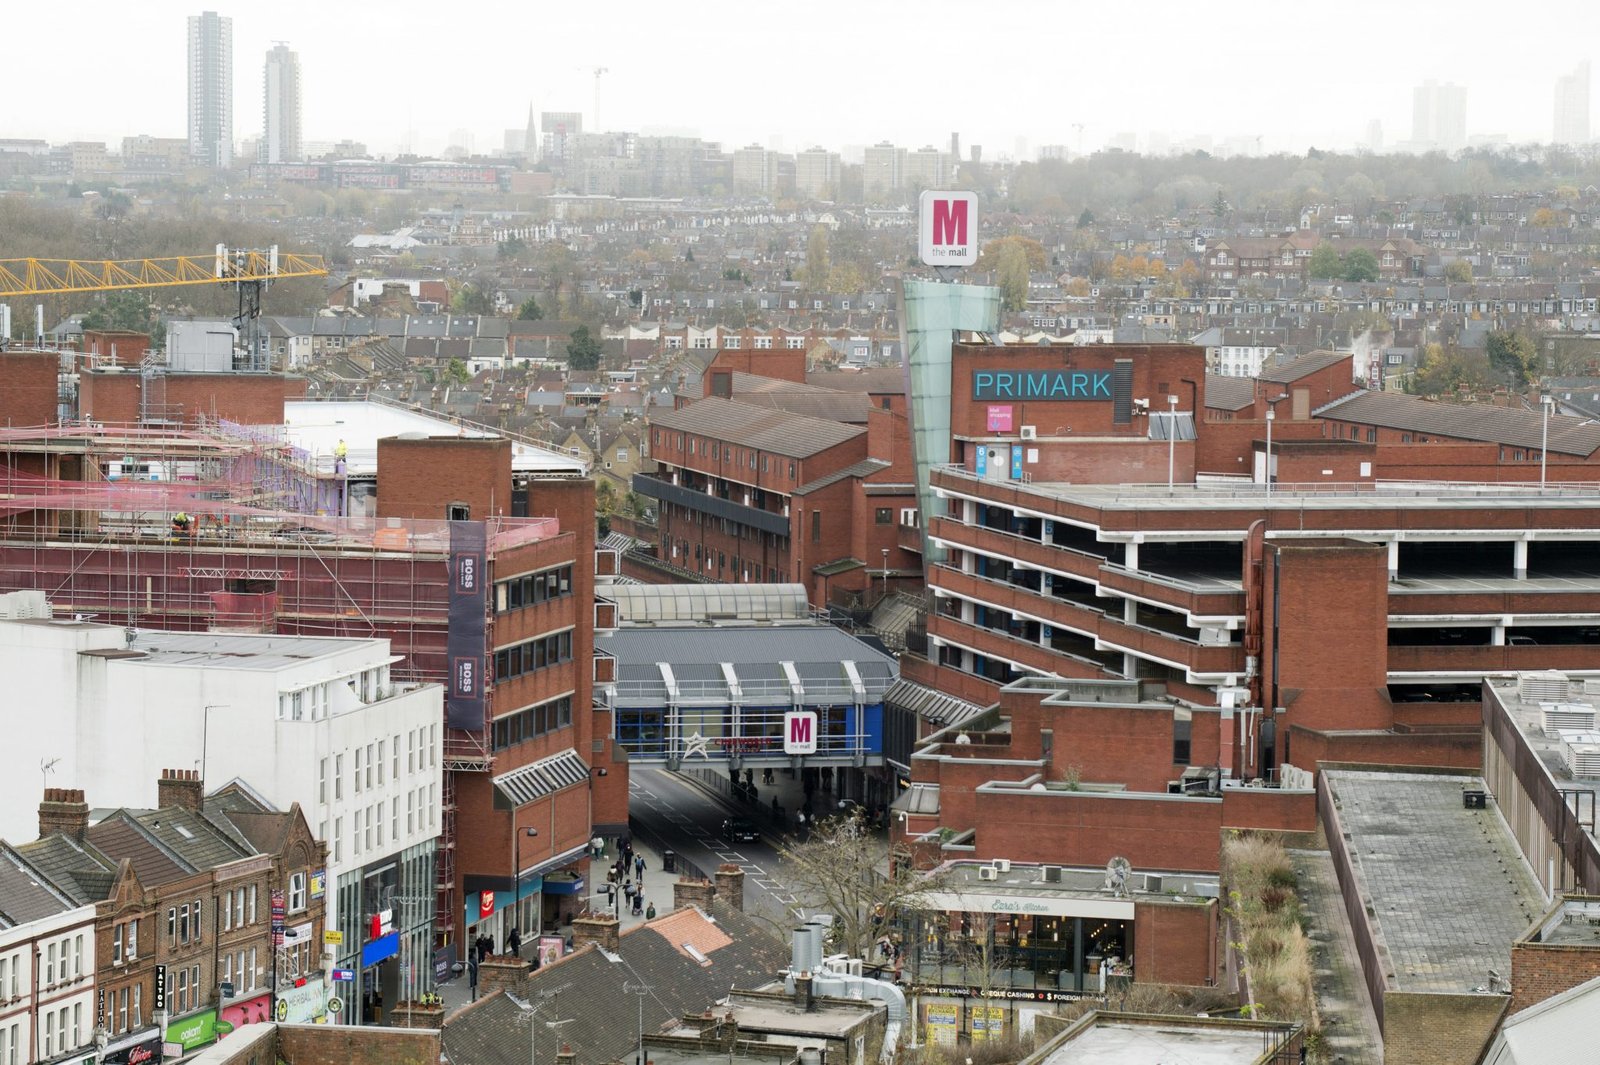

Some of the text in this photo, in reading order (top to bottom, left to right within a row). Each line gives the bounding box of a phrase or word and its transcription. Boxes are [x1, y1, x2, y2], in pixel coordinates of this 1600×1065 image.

[933, 200, 968, 245] M
[932, 248, 967, 256] the mall
[975, 373, 1111, 397] PRIMARK
[464, 559, 473, 588] BOSS
[463, 662, 472, 692] BOSS
[791, 718, 811, 742] M
[436, 960, 447, 972] BOSS
[1007, 991, 1035, 999] CASHING
[1046, 992, 1053, 1001] $
